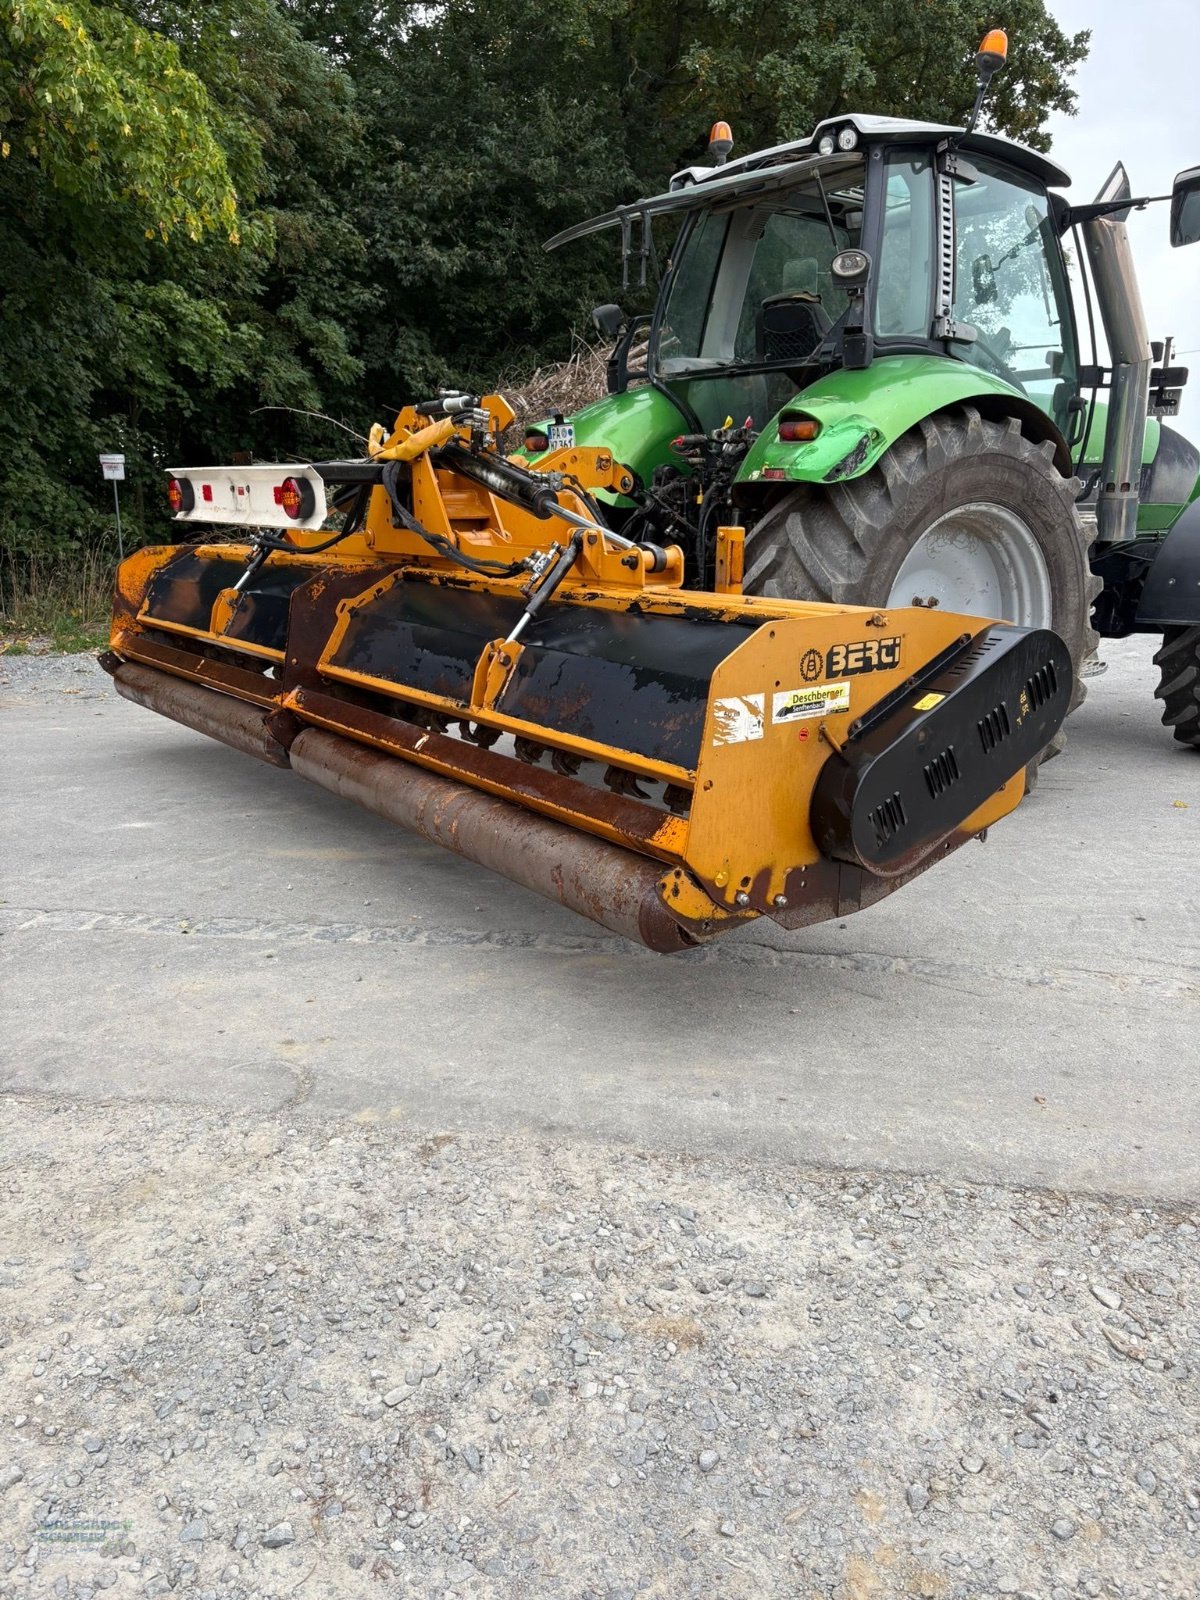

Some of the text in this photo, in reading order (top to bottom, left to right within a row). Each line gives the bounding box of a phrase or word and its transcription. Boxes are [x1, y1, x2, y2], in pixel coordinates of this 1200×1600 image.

[551, 427, 561, 439] PA
[793, 688, 844, 703] Deschberer
[793, 701, 825, 713] Senftenbach
